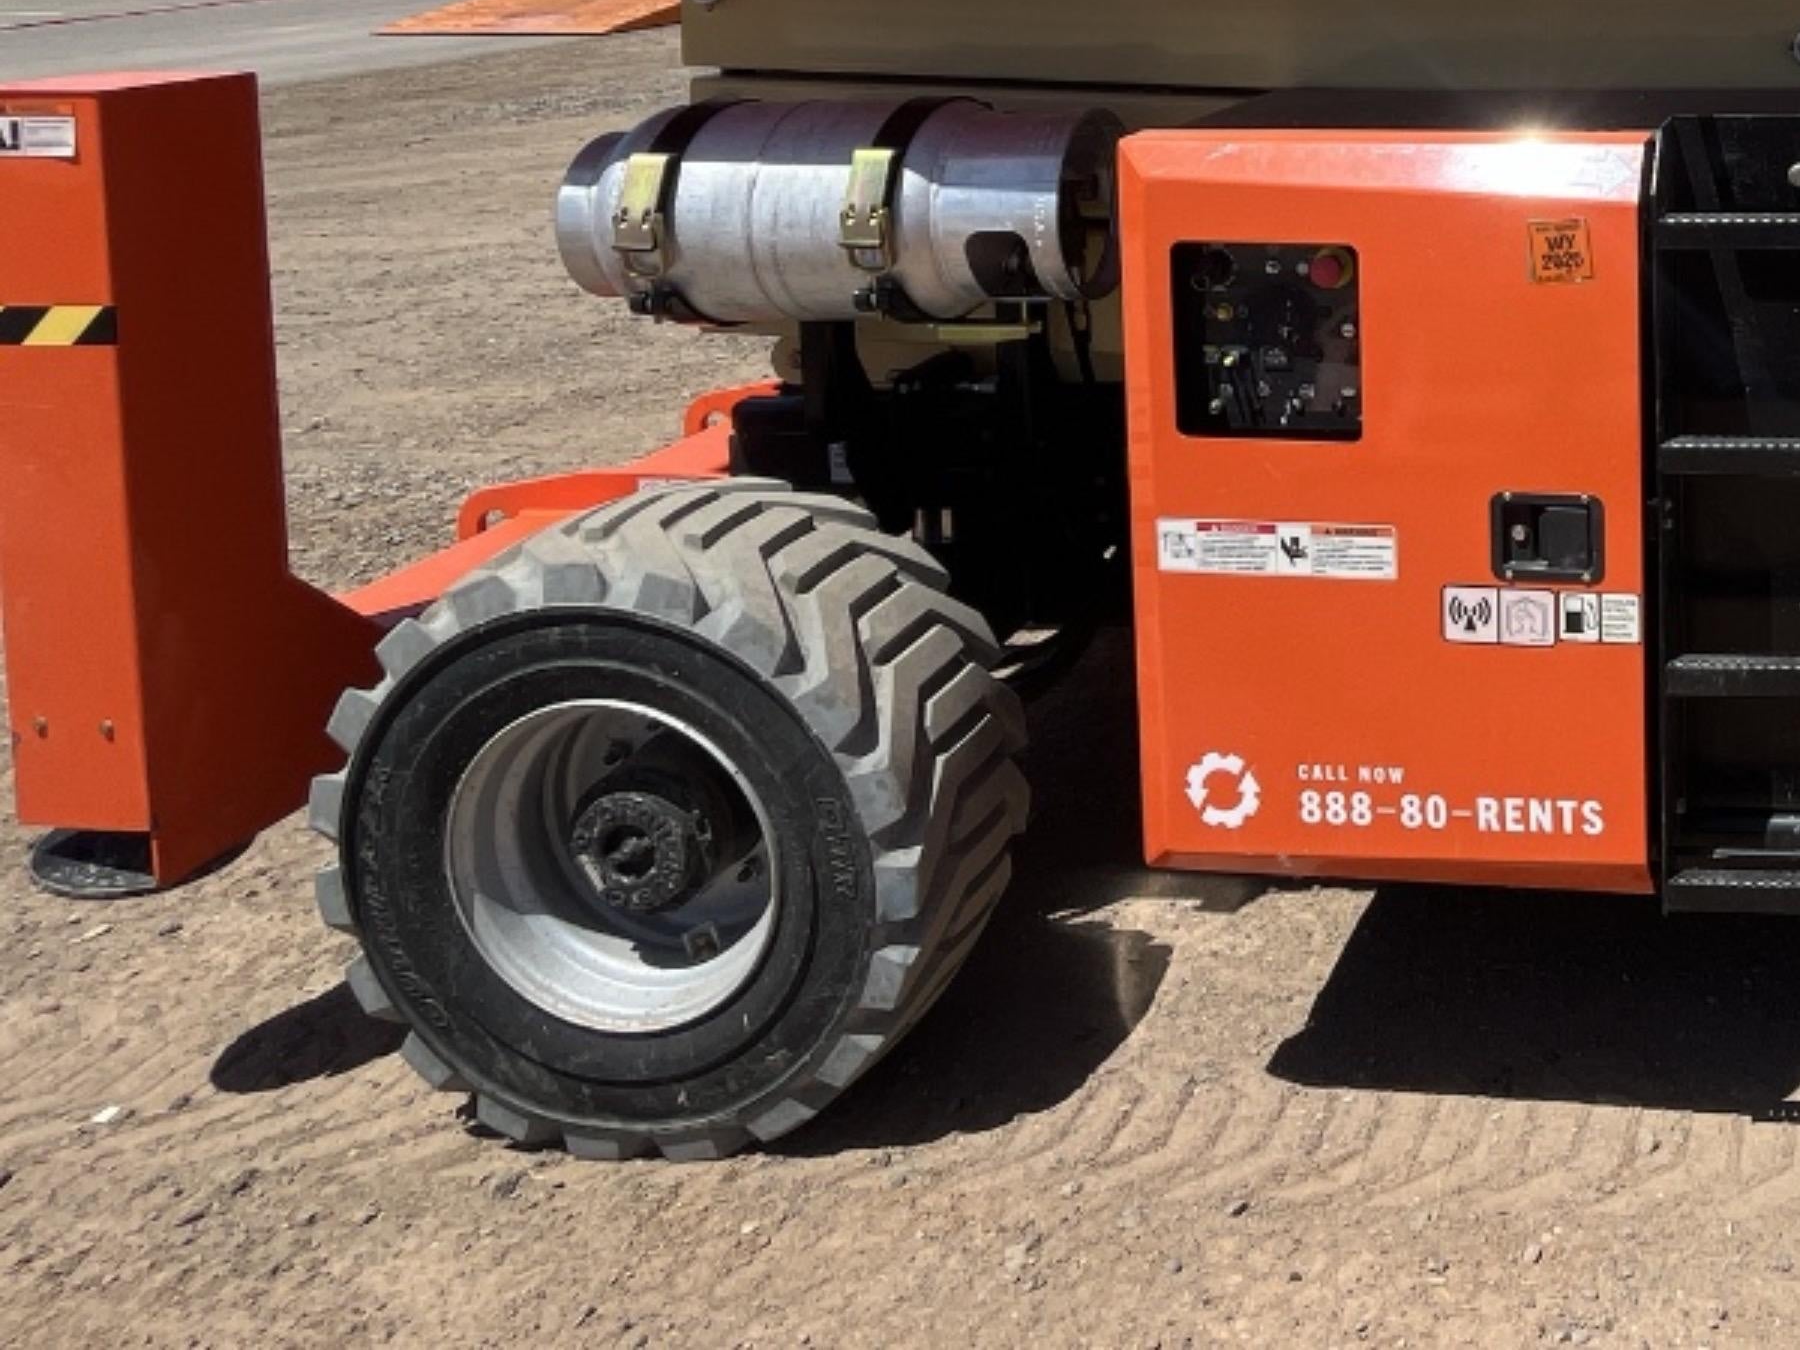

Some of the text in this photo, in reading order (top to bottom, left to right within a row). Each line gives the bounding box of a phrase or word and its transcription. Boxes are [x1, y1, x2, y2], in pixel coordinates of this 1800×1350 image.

[1297, 763, 1405, 784] CALL NOW
[1299, 788, 1605, 836] 888-80-RENTS
